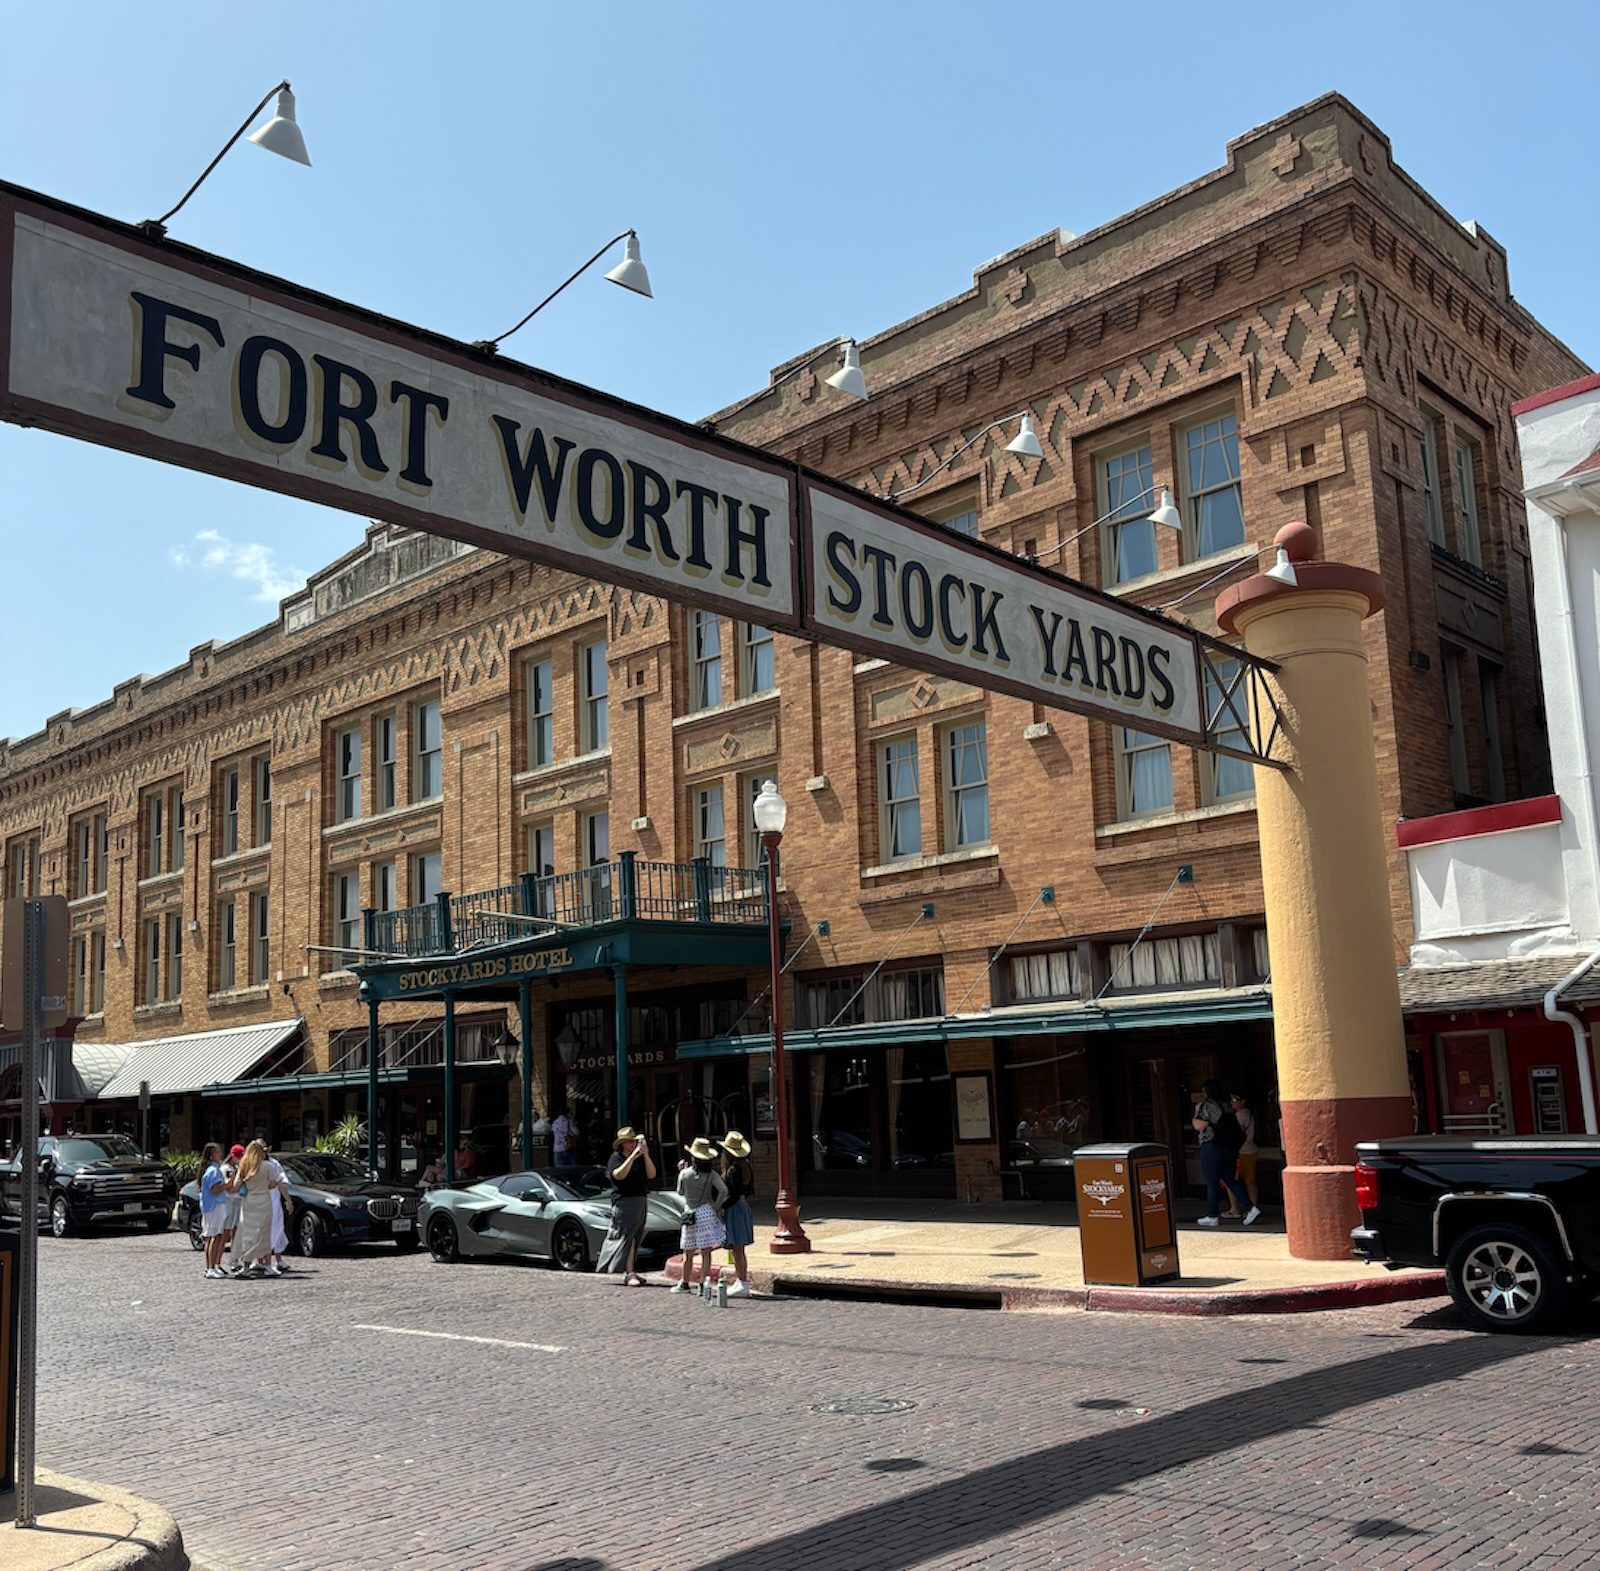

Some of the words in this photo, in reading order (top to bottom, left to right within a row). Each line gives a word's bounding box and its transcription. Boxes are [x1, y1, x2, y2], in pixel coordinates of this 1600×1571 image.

[125, 290, 450, 488] FORT
[491, 414, 773, 588] WORTH
[825, 531, 1011, 662] STOCK
[1029, 604, 1175, 711] YARDS
[399, 958, 507, 990] STOCKYARDS
[509, 947, 573, 974] HOTEL
[568, 1050, 665, 1070] TOCKARDS
